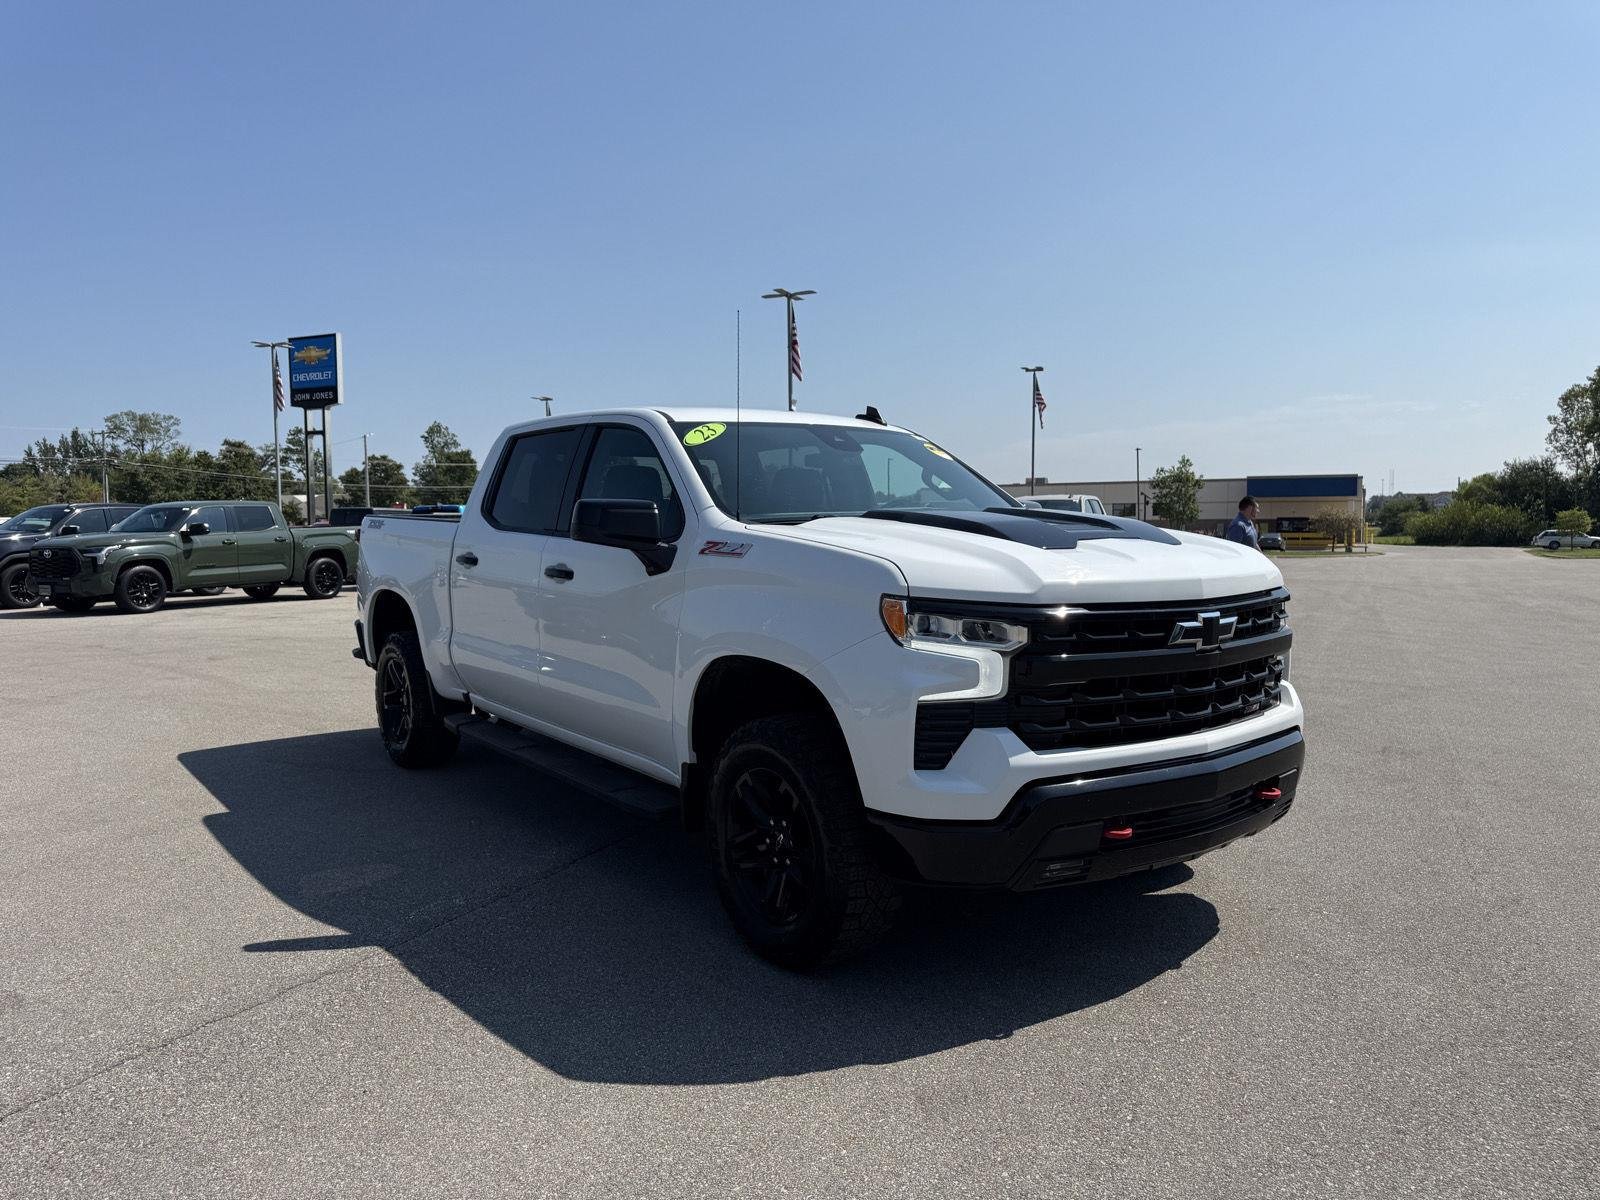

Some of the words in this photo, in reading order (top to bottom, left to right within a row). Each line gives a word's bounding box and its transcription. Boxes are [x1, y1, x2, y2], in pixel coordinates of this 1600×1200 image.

[292, 371, 333, 382] CHEVROLET
[294, 393, 310, 401] JOHN
[312, 391, 334, 400] JONES
[693, 425, 717, 441] 23
